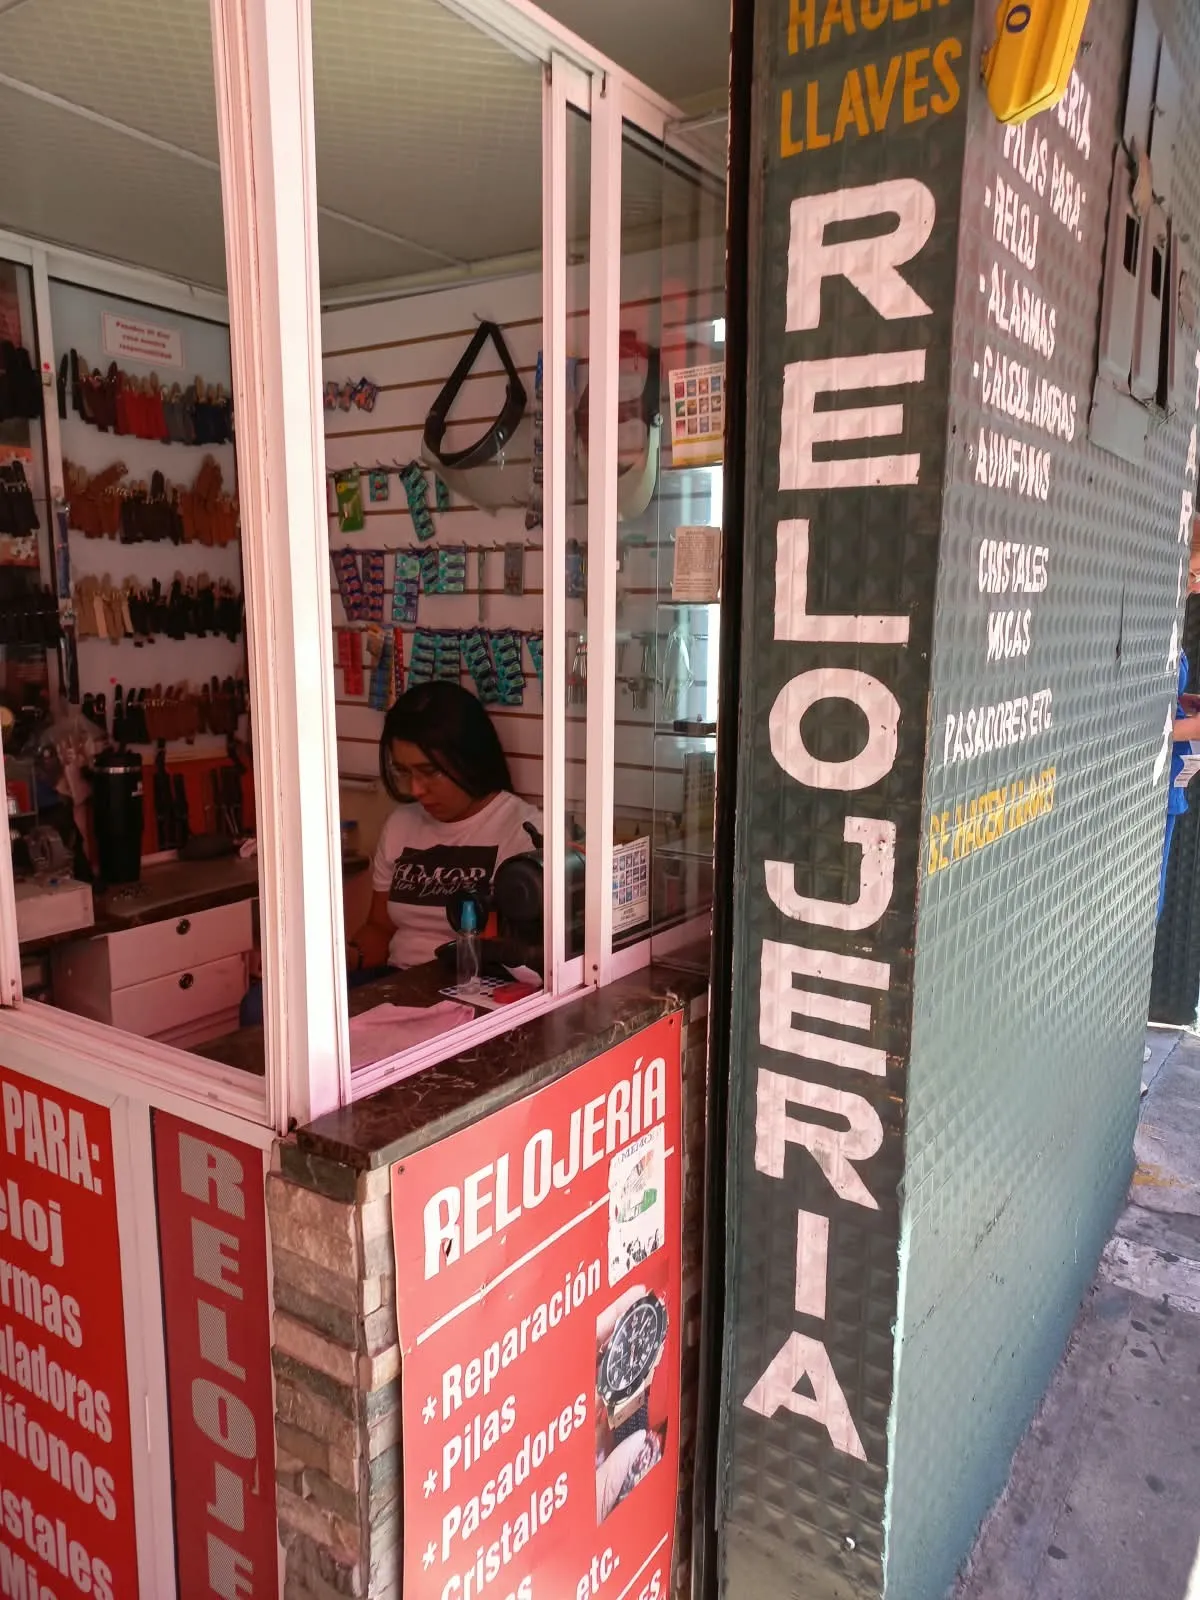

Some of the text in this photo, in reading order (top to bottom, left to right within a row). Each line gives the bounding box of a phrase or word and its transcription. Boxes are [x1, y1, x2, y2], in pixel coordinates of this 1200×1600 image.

[780, 37, 962, 159] LLAVES
[1051, 68, 1092, 160] ERIA
[1003, 119, 1048, 197] PILAS
[978, 538, 1049, 594] CRISTALES
[986, 608, 1032, 663] MICAS
[943, 695, 1029, 766] PASADORES
[743, 177, 936, 1462] RELOJERIA
[1, 1080, 103, 1195] PARA:
[424, 1056, 666, 1281] RELOJERÍA
[441, 1258, 601, 1422] Reparación
[0, 1389, 116, 1520] ífonos
[441, 1394, 517, 1493] Pilas
[441, 1391, 588, 1563] Pasadores
[0, 1484, 115, 1600] stales
[577, 1546, 621, 1600] etc.
